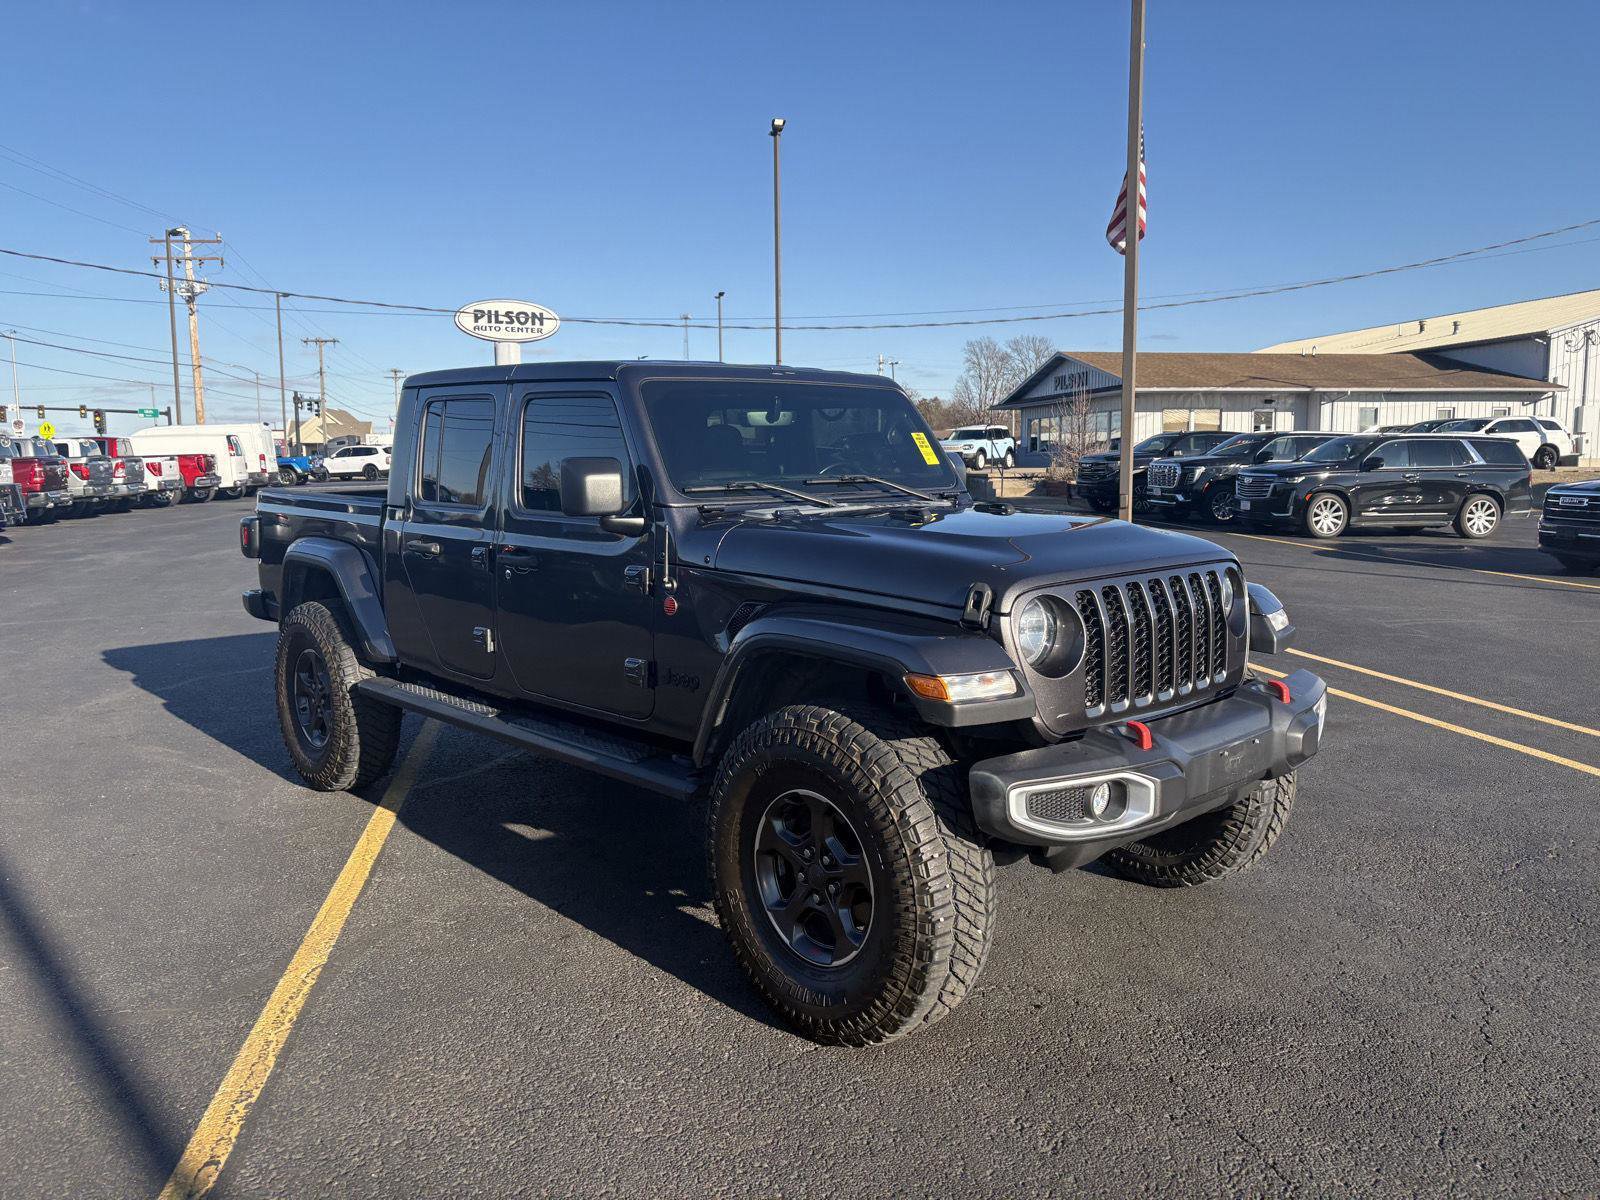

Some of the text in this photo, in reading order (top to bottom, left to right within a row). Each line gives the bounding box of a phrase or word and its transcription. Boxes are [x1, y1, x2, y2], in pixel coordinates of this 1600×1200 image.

[473, 309, 544, 326] PILSON
[504, 326, 544, 334] CENTER
[1054, 370, 1088, 391] PILSON
